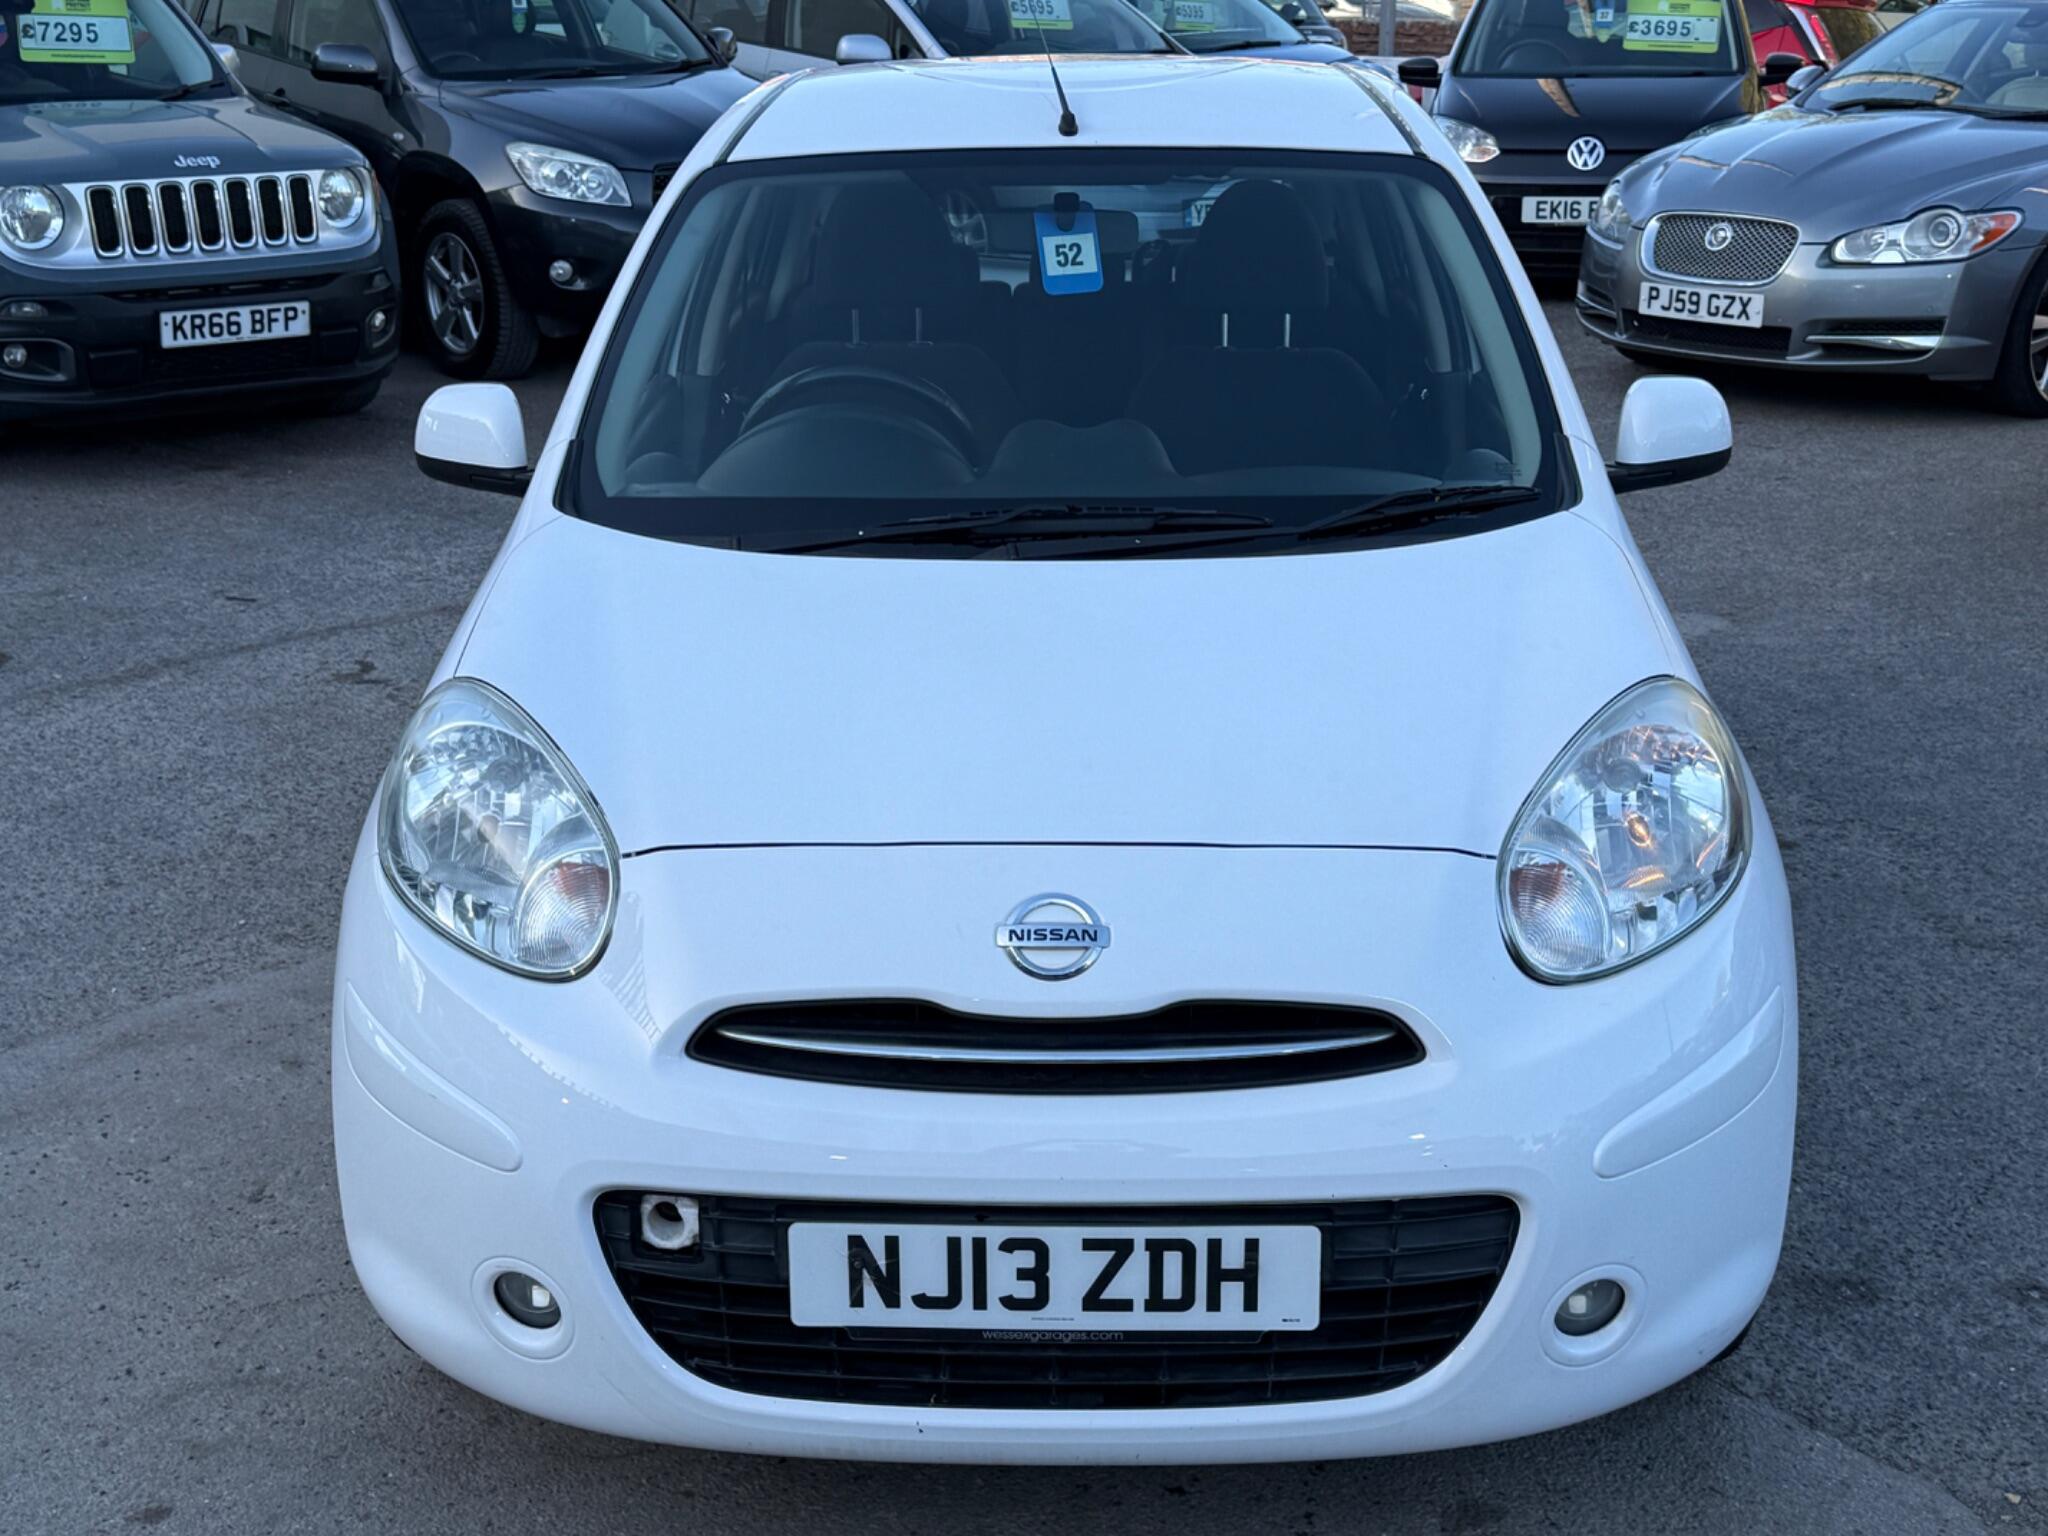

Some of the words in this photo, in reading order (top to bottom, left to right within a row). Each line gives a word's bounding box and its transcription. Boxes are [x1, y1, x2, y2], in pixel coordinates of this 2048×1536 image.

[21, 21, 99, 44] £7295
[1628, 19, 1692, 37] £3695
[174, 155, 220, 169] Jeep
[1535, 200, 1582, 220] EK16
[1055, 242, 1084, 268] 52
[1647, 286, 1701, 315] PJ59
[1706, 293, 1752, 321] GZX
[171, 310, 242, 342] KR66
[249, 306, 299, 335] BFP
[1008, 928, 1098, 942] NISSAN
[847, 1234, 1051, 1312] NJ13
[1081, 1237, 1260, 1313] ZDH
[981, 1329, 1124, 1343] wessexgarages.com
